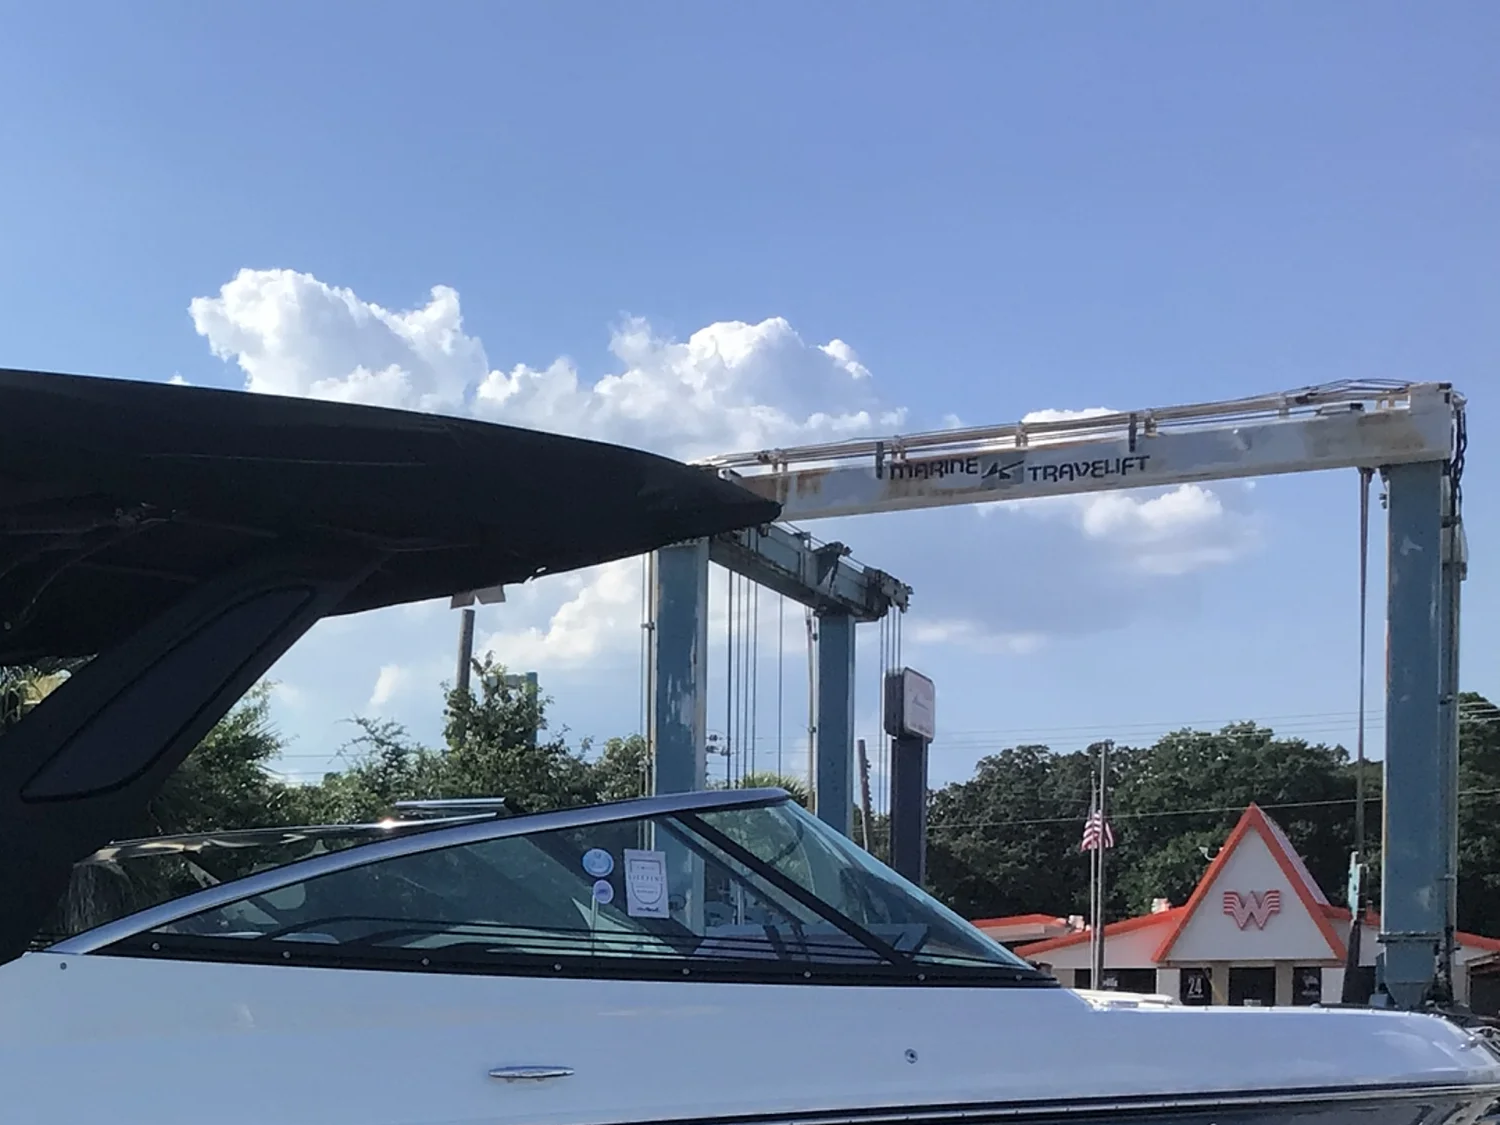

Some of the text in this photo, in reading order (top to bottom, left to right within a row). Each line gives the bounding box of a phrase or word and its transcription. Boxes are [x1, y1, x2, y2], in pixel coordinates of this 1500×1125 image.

[890, 455, 1150, 482] MARINE TRAVELIFT
[1223, 889, 1280, 931] W
[1187, 977, 1203, 995] 24
